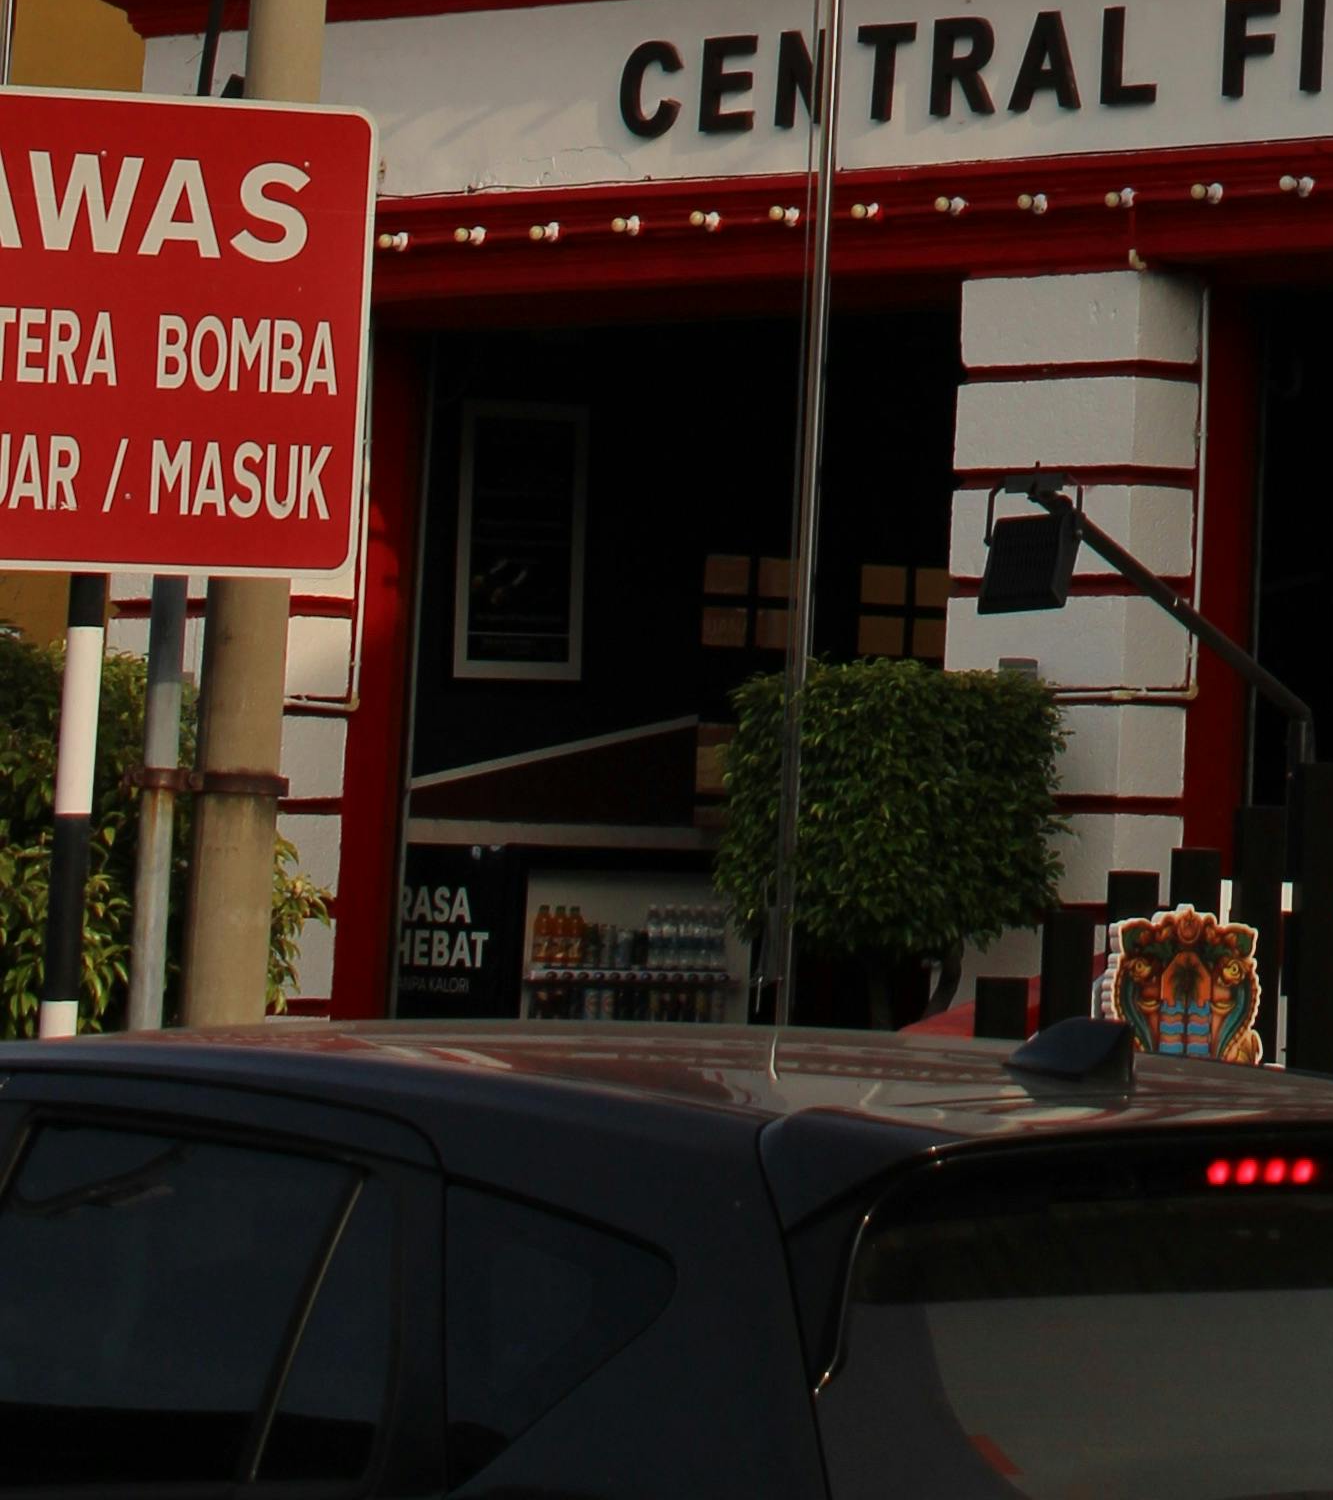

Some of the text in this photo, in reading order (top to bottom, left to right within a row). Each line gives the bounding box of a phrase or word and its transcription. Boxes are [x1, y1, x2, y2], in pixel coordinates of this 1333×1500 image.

[618, 5, 1157, 141] CENTRAL
[0, 150, 311, 263] WAS
[155, 313, 338, 396] BOMBA
[149, 438, 333, 521] MASUK
[400, 885, 472, 924] RASA
